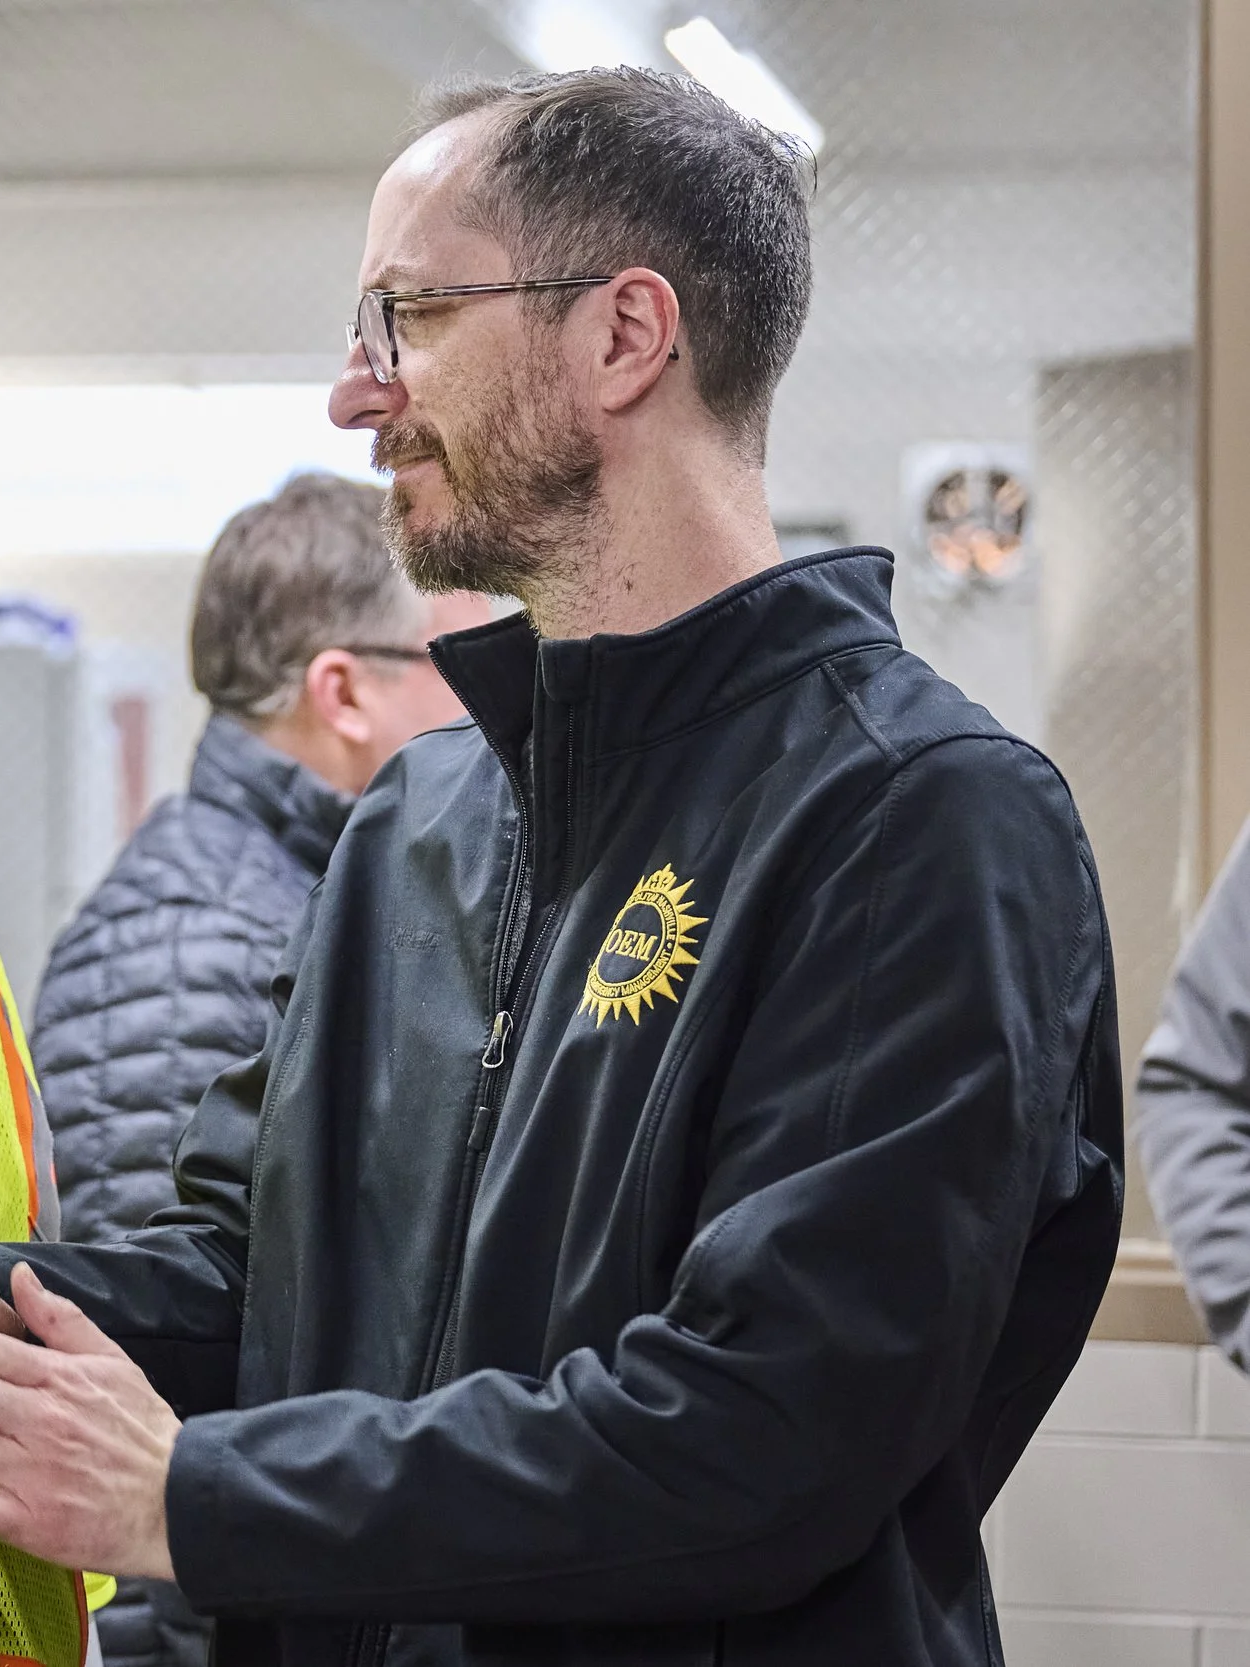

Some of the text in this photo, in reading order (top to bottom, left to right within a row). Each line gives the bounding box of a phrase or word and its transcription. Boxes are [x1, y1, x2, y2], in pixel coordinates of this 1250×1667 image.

[655, 895, 676, 940] NASHVILLE
[605, 928, 658, 962] OEM
[621, 948, 672, 997] MANAGEMENT
